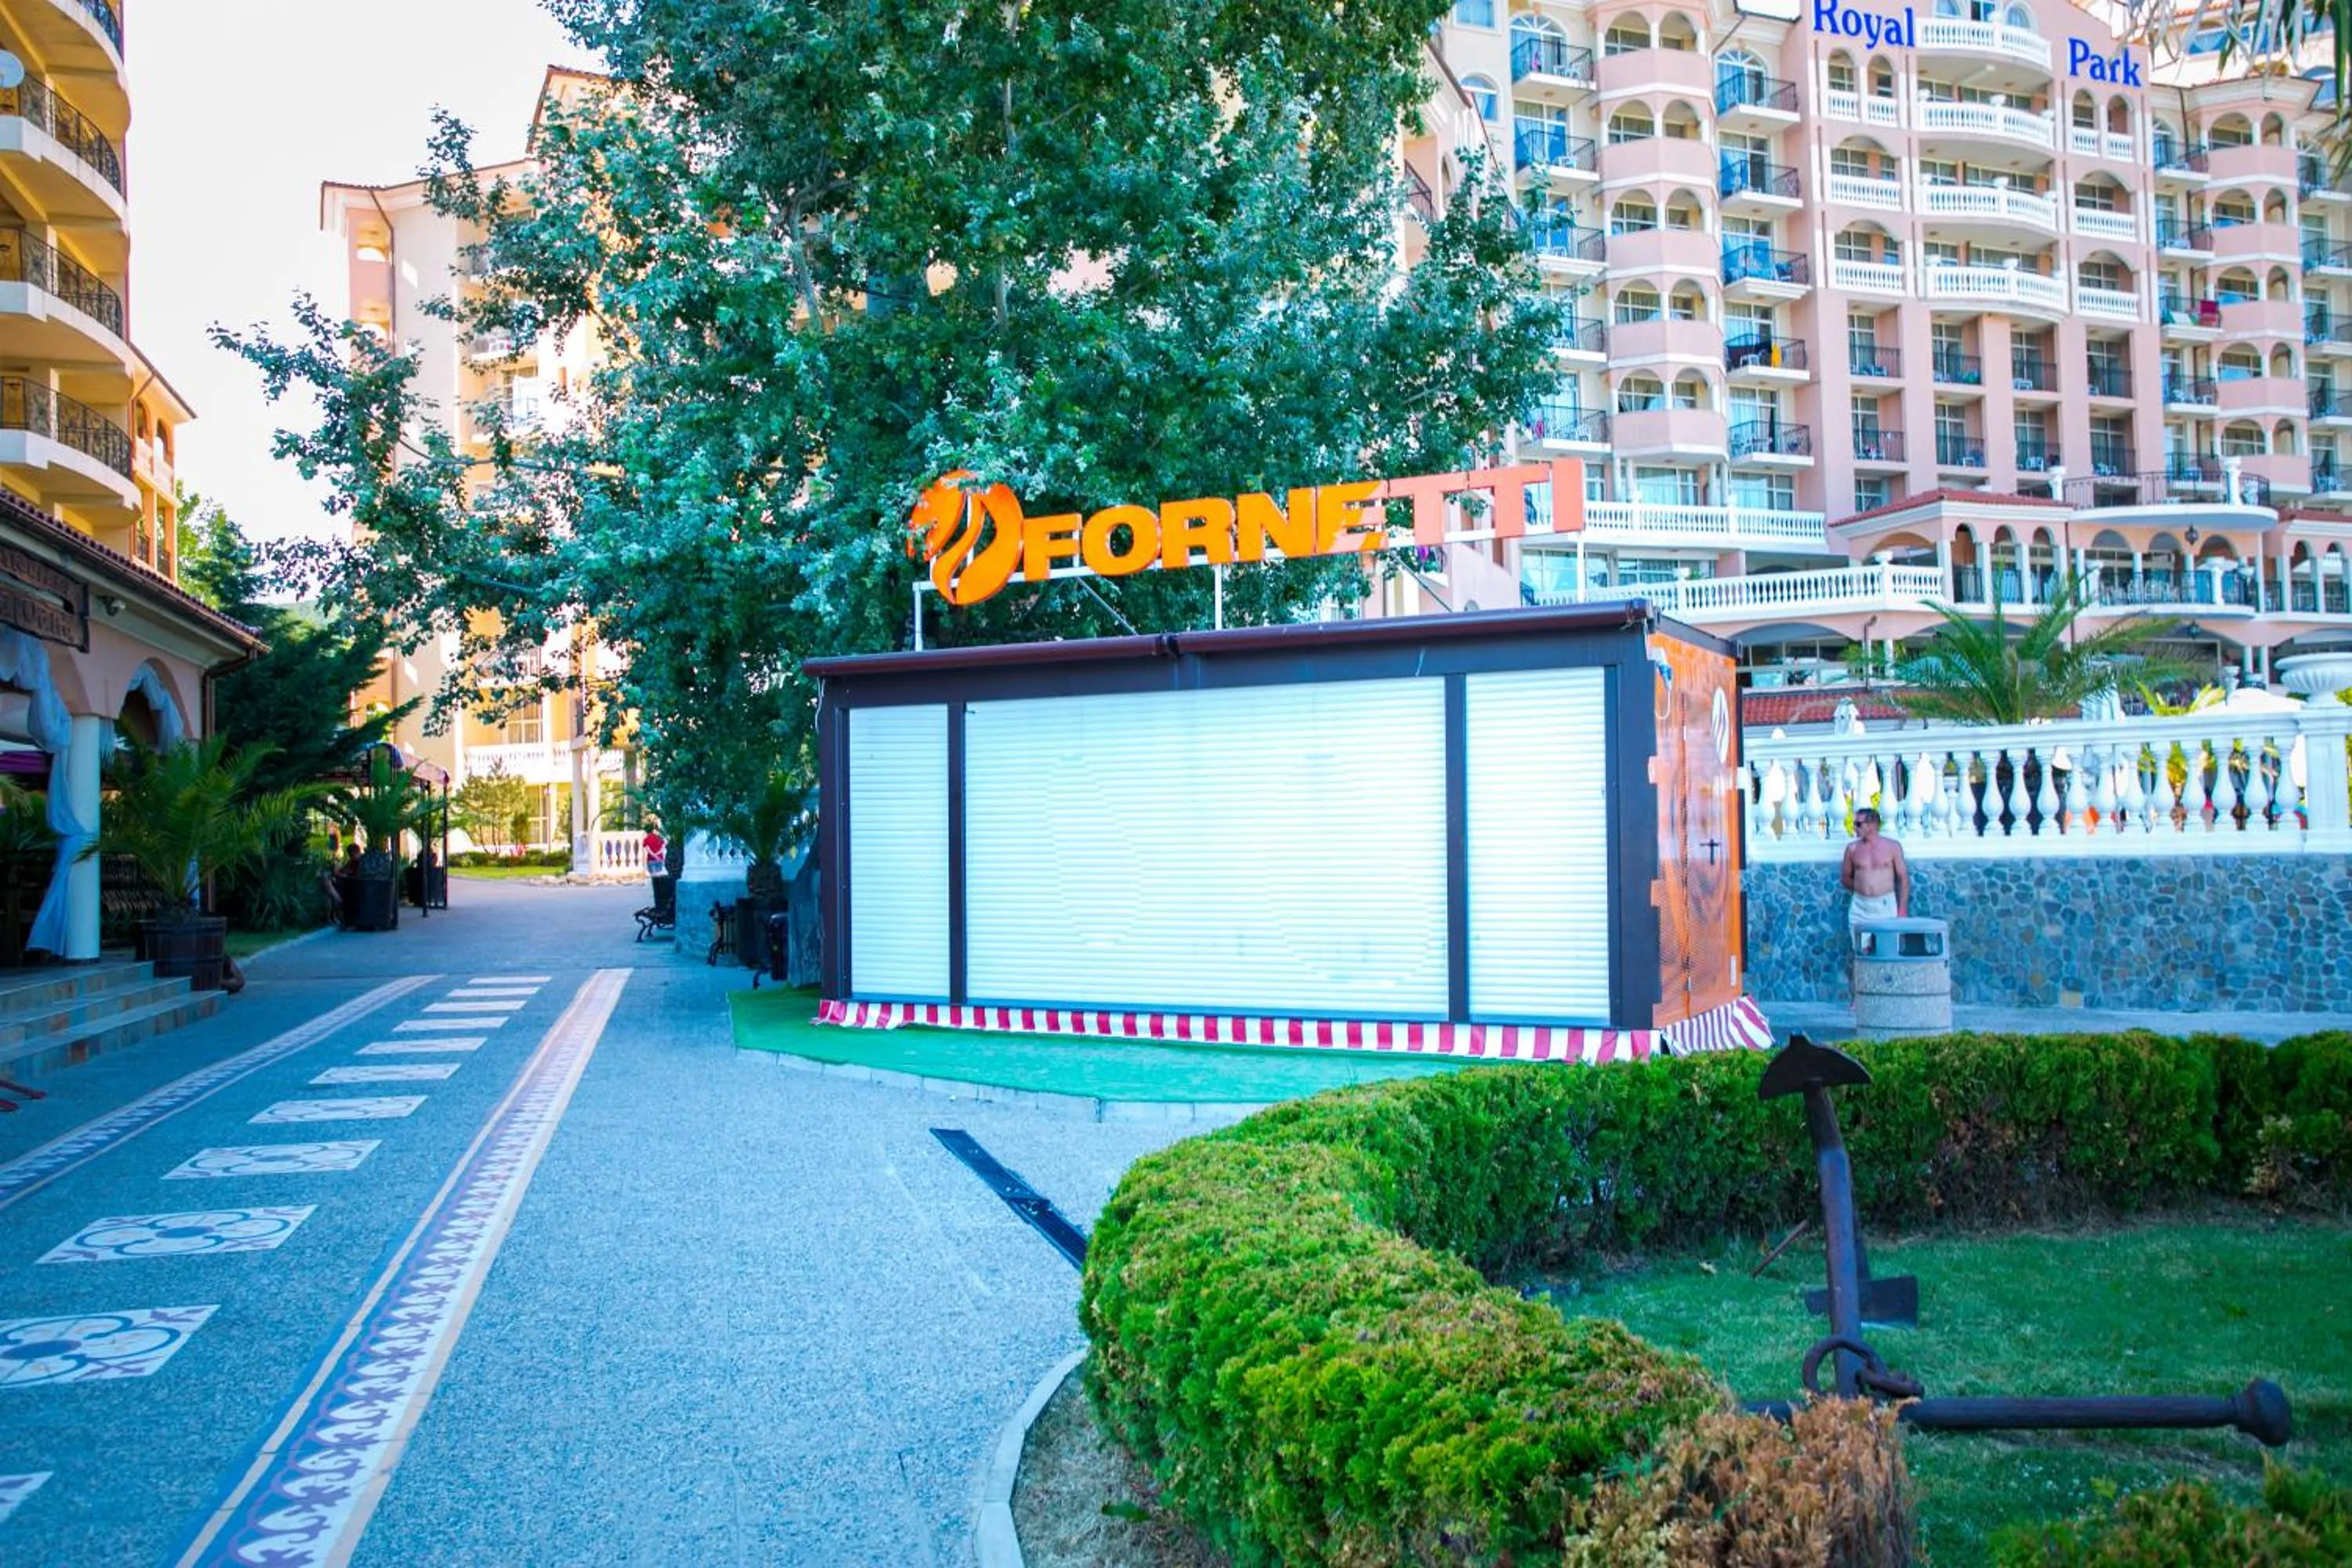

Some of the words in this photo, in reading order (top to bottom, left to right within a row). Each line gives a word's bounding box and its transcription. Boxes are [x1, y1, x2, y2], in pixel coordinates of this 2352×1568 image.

[1813, 0, 1915, 49] Royal
[2068, 37, 2142, 87] Park
[1022, 458, 1584, 582] FORNETTI
